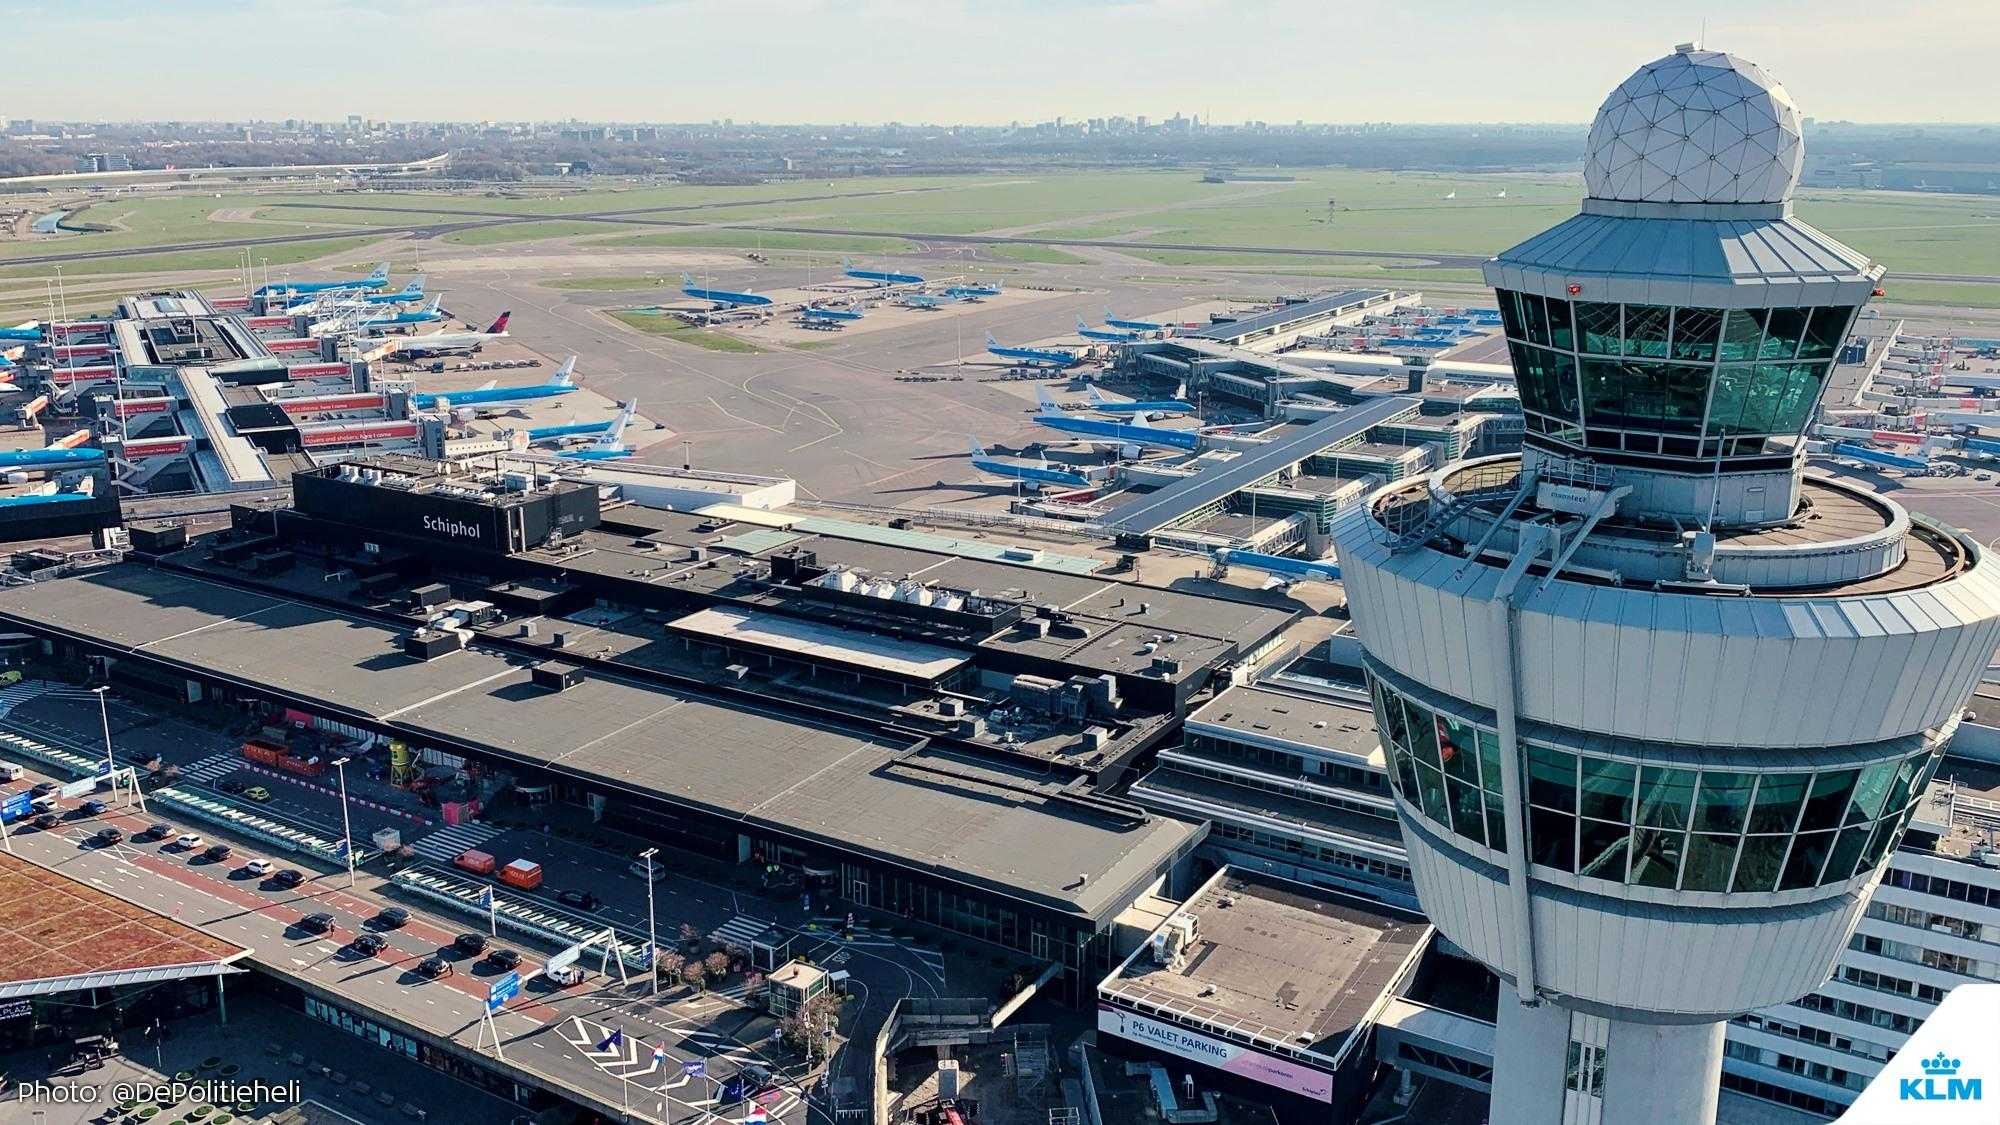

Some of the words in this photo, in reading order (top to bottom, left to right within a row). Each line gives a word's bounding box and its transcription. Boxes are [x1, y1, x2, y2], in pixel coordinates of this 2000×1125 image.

[423, 515, 480, 539] Schiphol
[1132, 1020, 1145, 1032] P6
[1147, 1025, 1179, 1043] VALET
[1181, 1036, 1228, 1058] PARKING
